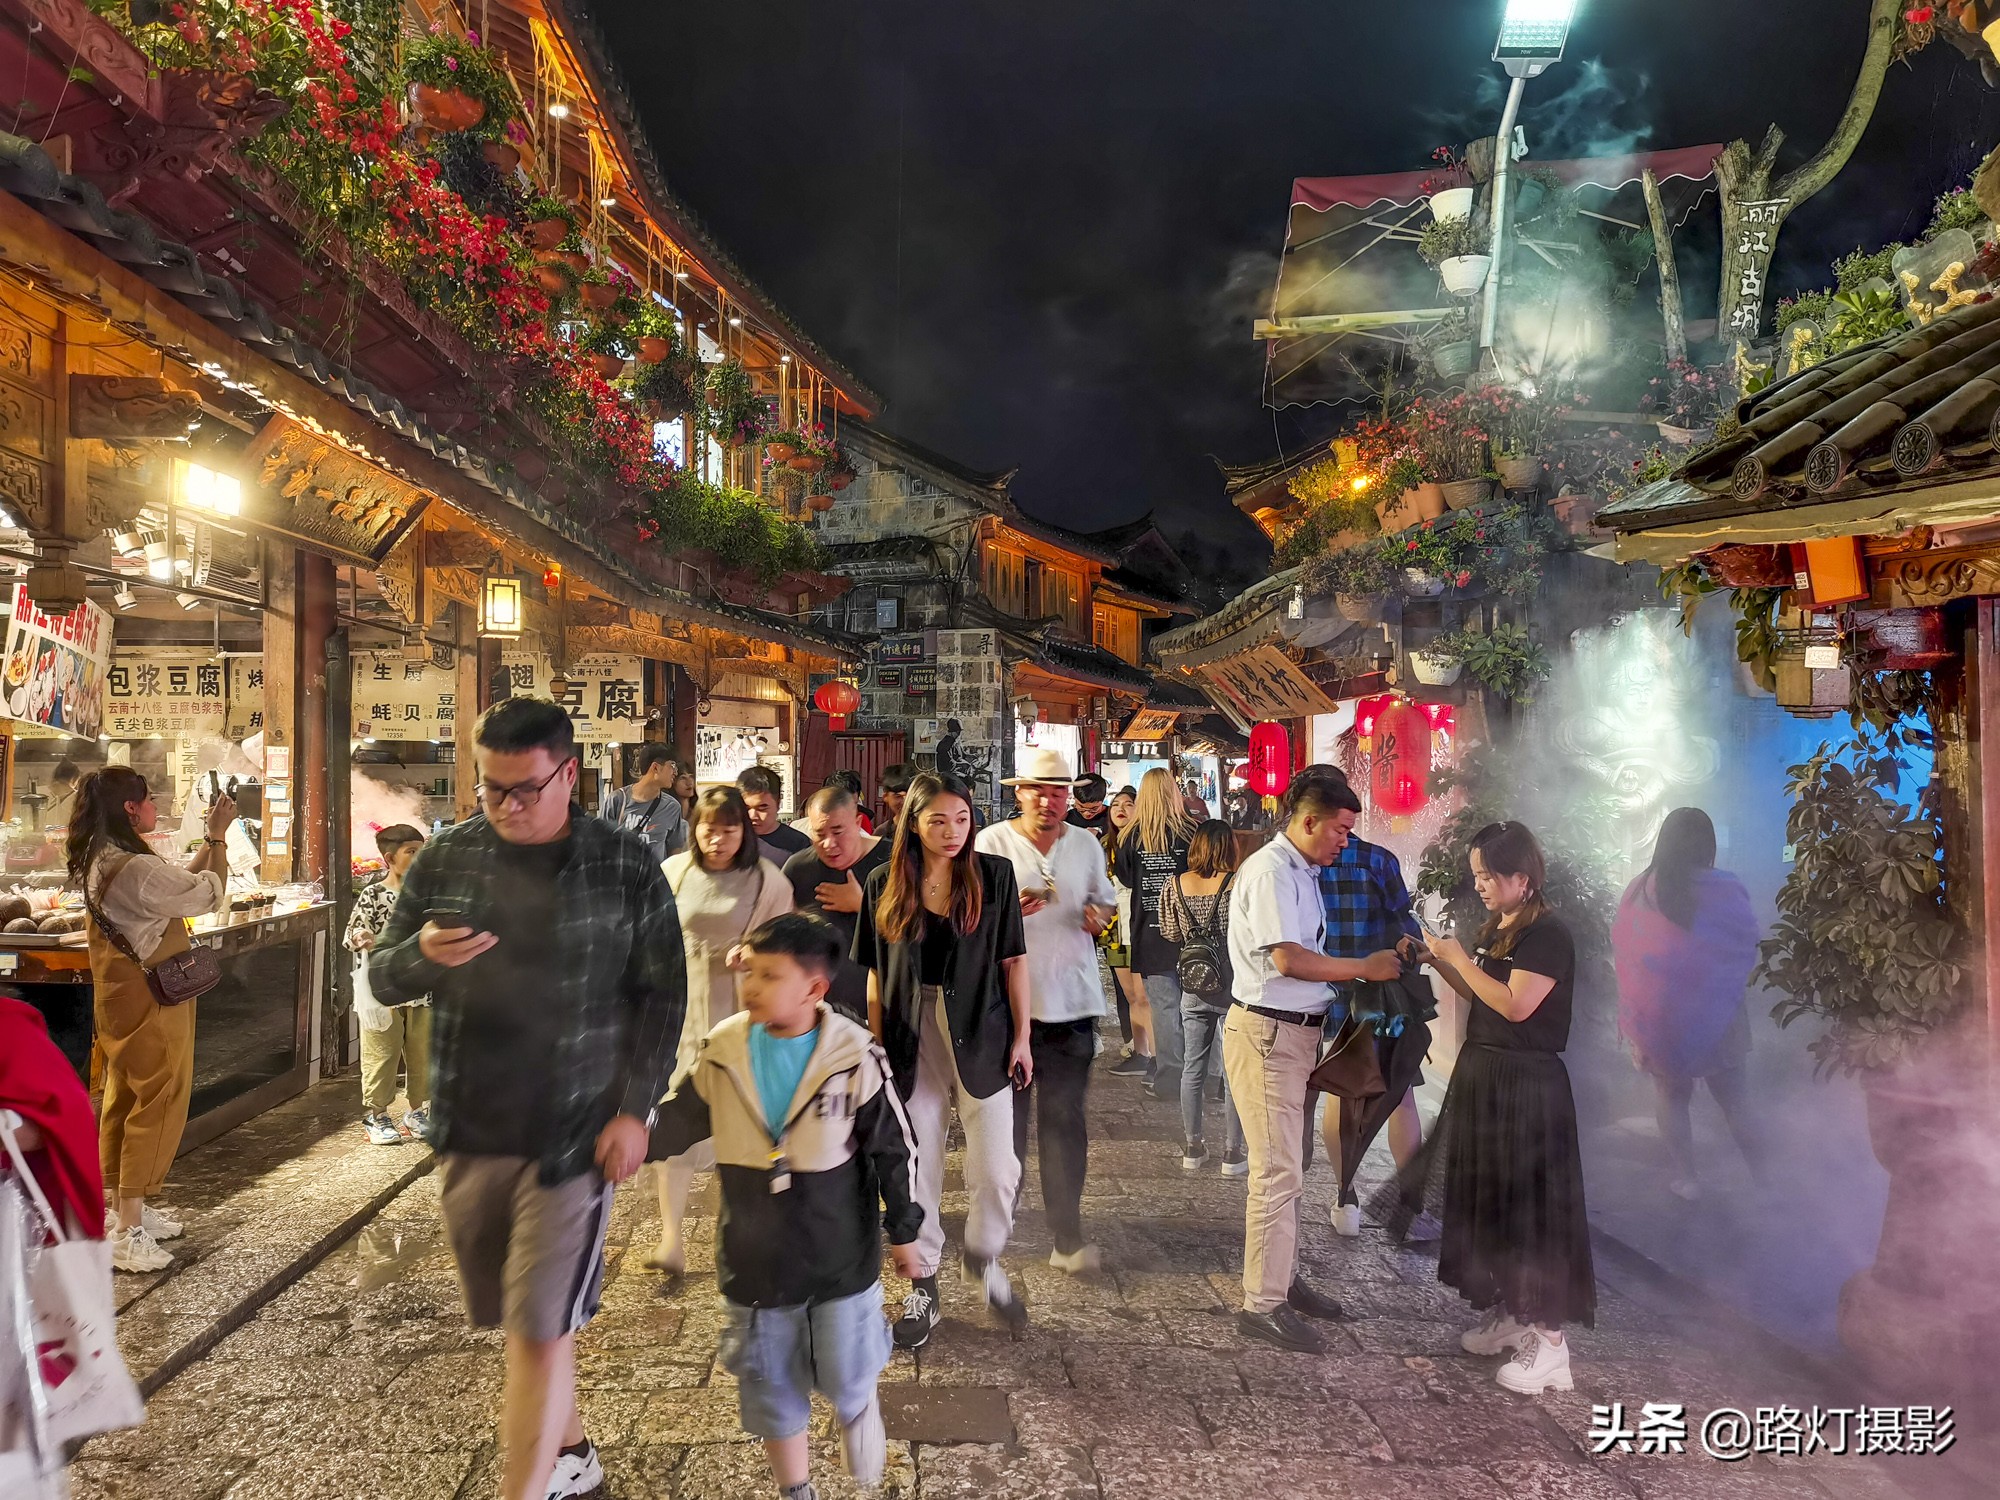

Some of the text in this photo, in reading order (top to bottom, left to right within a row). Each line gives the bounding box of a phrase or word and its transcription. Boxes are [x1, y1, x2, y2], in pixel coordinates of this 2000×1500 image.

[1730, 198, 1790, 336] 丽江古城
[977, 633, 993, 655] 寻
[106, 663, 221, 698] 包浆豆腐
[108, 701, 223, 715] 云南十八怪 豆腐包浆卖
[436, 693, 456, 720] 豆腐
[559, 678, 640, 721] 豆腐
[114, 717, 196, 731] 舌尖包浆豆腐
